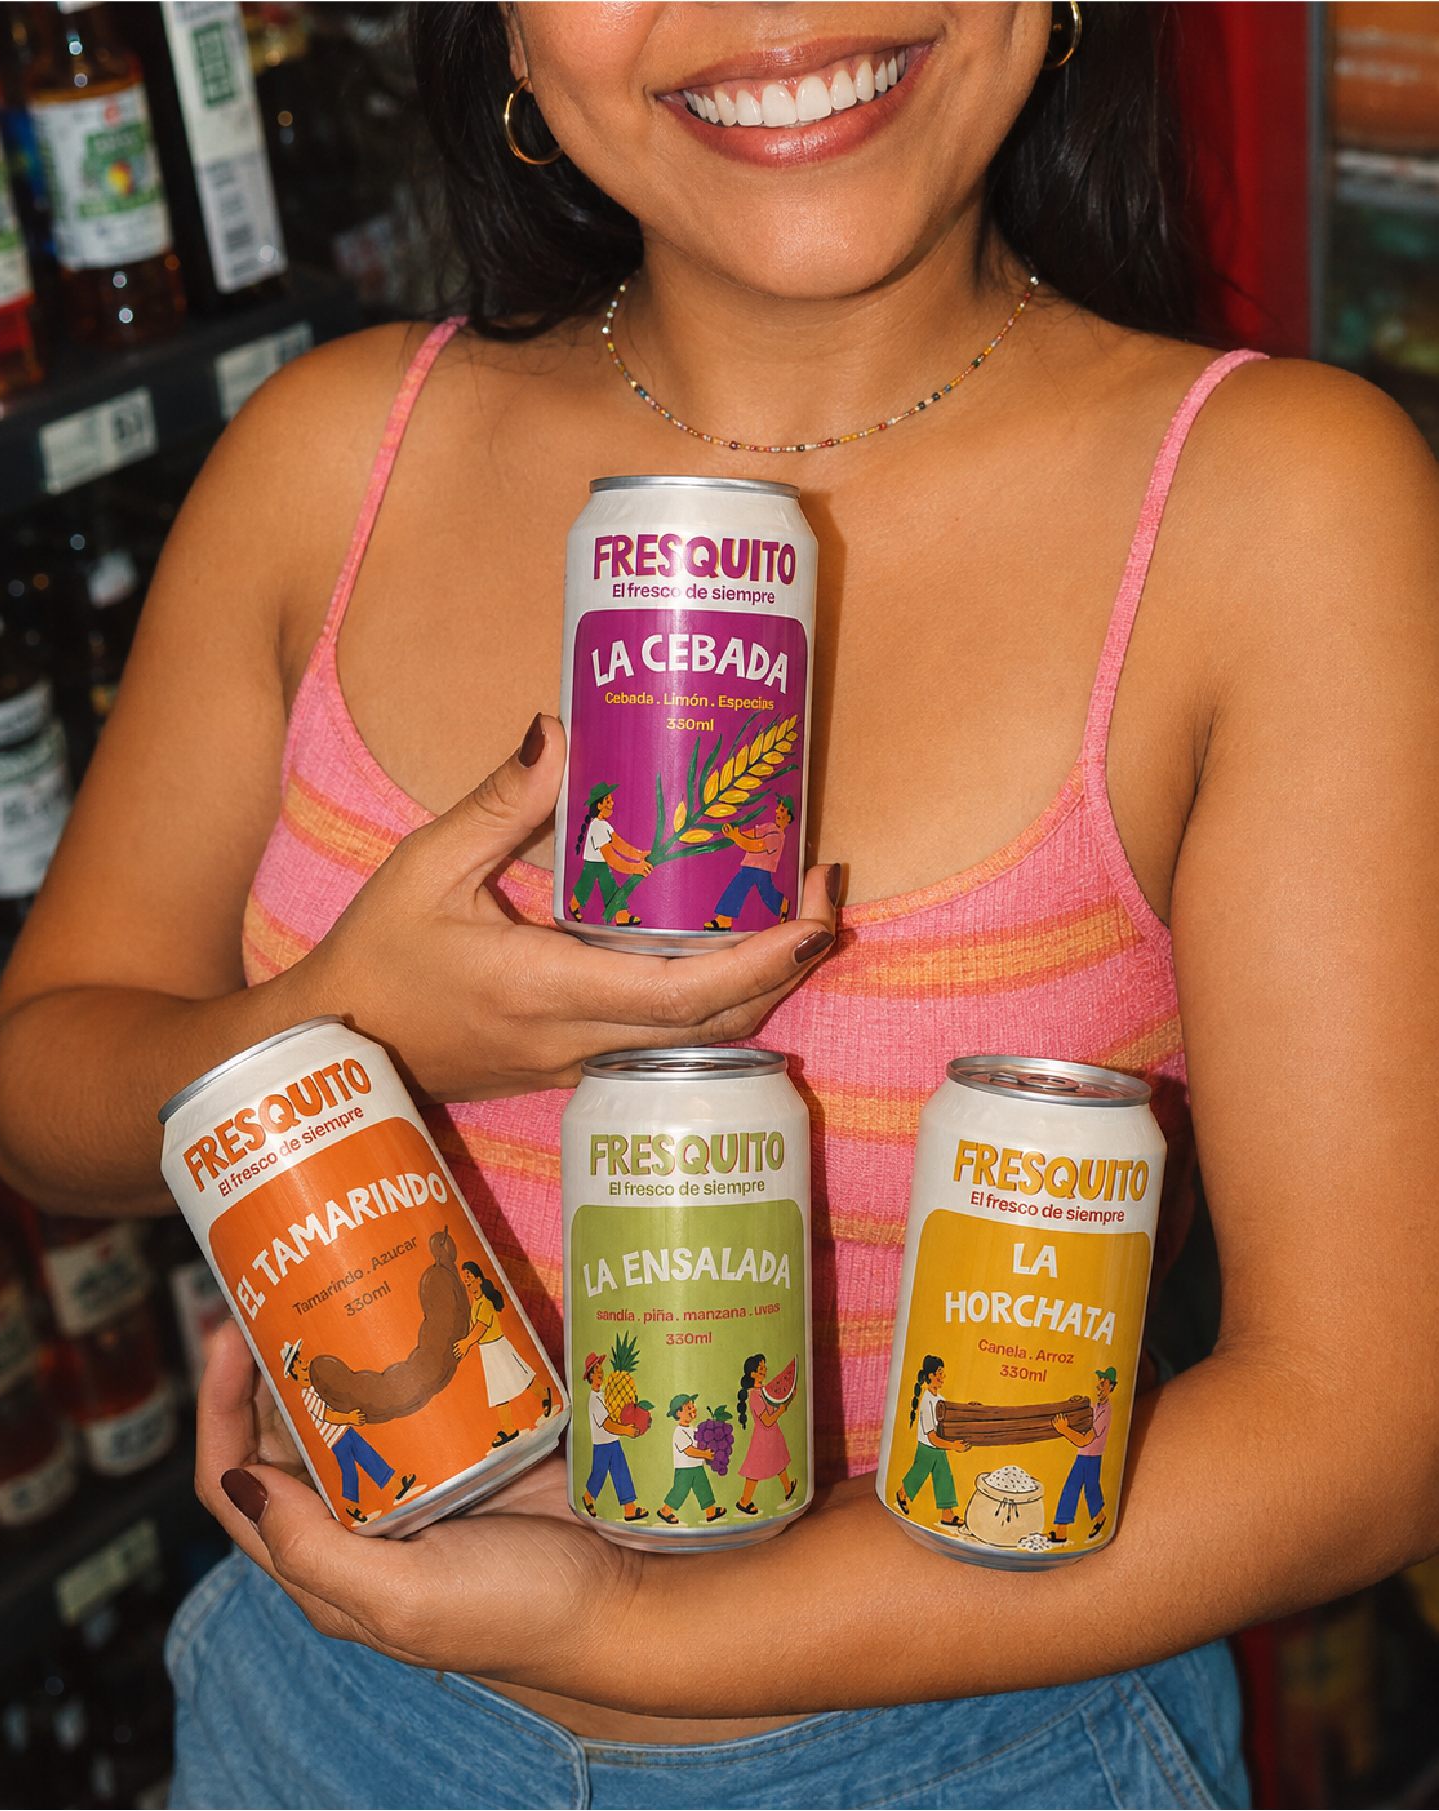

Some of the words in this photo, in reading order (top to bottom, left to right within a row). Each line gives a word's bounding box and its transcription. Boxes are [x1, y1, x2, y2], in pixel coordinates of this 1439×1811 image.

[594, 533, 796, 585] FRESQUITO
[612, 583, 625, 597] El
[627, 583, 680, 597] fresco
[685, 584, 707, 598] de
[712, 586, 775, 605] siempre
[592, 640, 634, 687] LA
[642, 634, 788, 694] CEBADA
[605, 692, 654, 705] Cebada
[664, 694, 707, 707] Limón
[183, 1058, 371, 1192] FRESQUITO
[218, 1181, 232, 1197] El
[231, 1151, 278, 1188] fresco
[279, 1138, 301, 1156] de
[301, 1106, 364, 1144] siempre
[590, 1131, 784, 1175] FRESQUITO
[953, 1139, 1149, 1201] FRESQUITO
[609, 1182, 621, 1195] El
[625, 1181, 674, 1196] fresco
[679, 1182, 700, 1195] de
[704, 1179, 765, 1196] siempre
[971, 1191, 984, 1205] El
[986, 1196, 1038, 1214] fresco
[1042, 1204, 1062, 1219] de
[1066, 1206, 1125, 1225] siempre
[236, 1275, 266, 1320] EL
[252, 1172, 448, 1286] TAMARINDO
[1013, 1243, 1057, 1278] LA
[292, 1269, 363, 1316] Tamarindo
[583, 1258, 618, 1297] LA
[622, 1248, 791, 1289] ENSALADA
[344, 1281, 390, 1317] 330ml
[596, 1308, 635, 1321] sandía
[644, 1309, 673, 1324] piña
[684, 1307, 746, 1321] manzana
[754, 1303, 780, 1315] uvas
[945, 1290, 1115, 1346] HORCHATA
[666, 1332, 712, 1345] 330ml
[978, 1339, 1026, 1359] Canela
[1036, 1350, 1074, 1364] Arroz
[1000, 1365, 1047, 1382] 330ml
